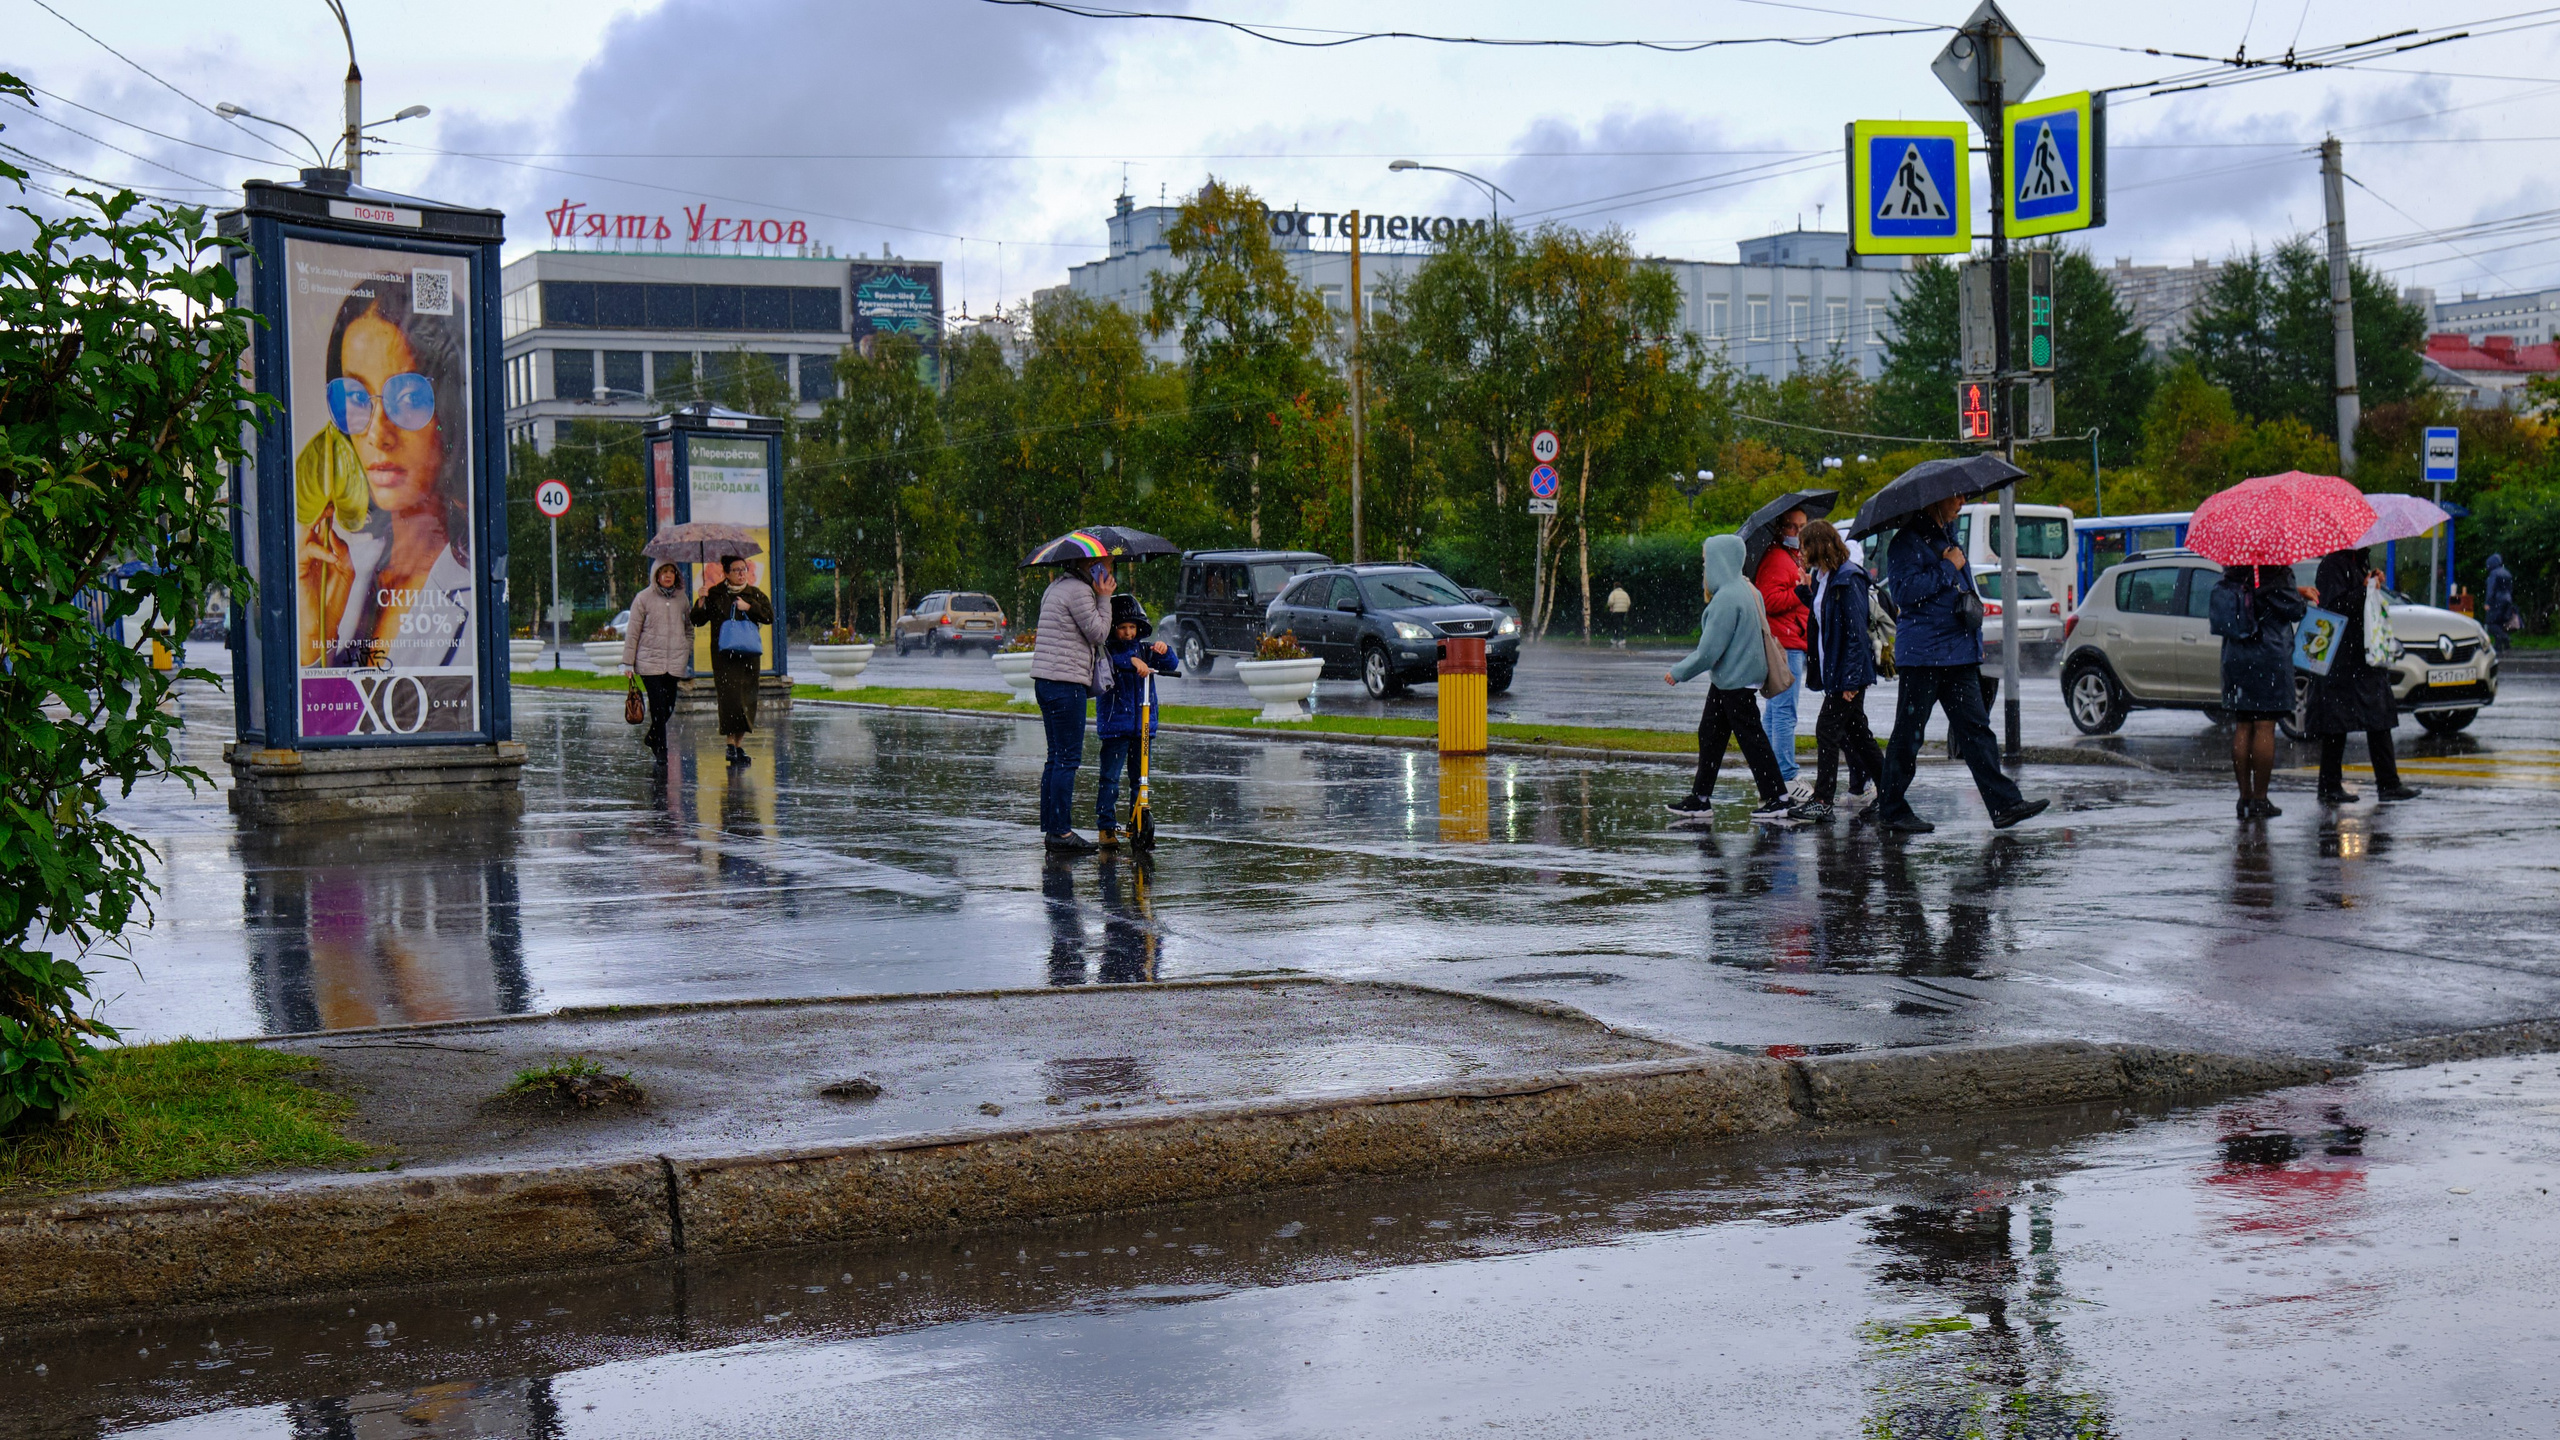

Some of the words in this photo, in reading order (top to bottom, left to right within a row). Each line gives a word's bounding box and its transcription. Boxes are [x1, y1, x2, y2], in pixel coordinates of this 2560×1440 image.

[354, 207, 394, 222] ПО-07В
[546, 199, 671, 239] Пять
[683, 204, 807, 244] Углов
[310, 265, 405, 283] vk.com/horoshieochki
[874, 291, 916, 301] Бренд-Шеф
[909, 301, 933, 310] Кухни
[2031, 295, 2050, 326] 32
[1963, 410, 1989, 436] 70
[700, 446, 760, 461] Перекрёсток
[1536, 440, 1554, 453] 40
[692, 471, 724, 481] ЛЕТНЯЯ
[692, 482, 761, 494] РАСПРОДАЖА
[542, 491, 564, 505] 40
[376, 588, 467, 611] СКИДКА
[312, 639, 325, 649] НА
[326, 638, 342, 649] ВСЕ
[437, 638, 466, 648] ОЧКИ
[306, 702, 359, 712] ХОРОШИЕ
[433, 699, 468, 708] ОЧКИ
